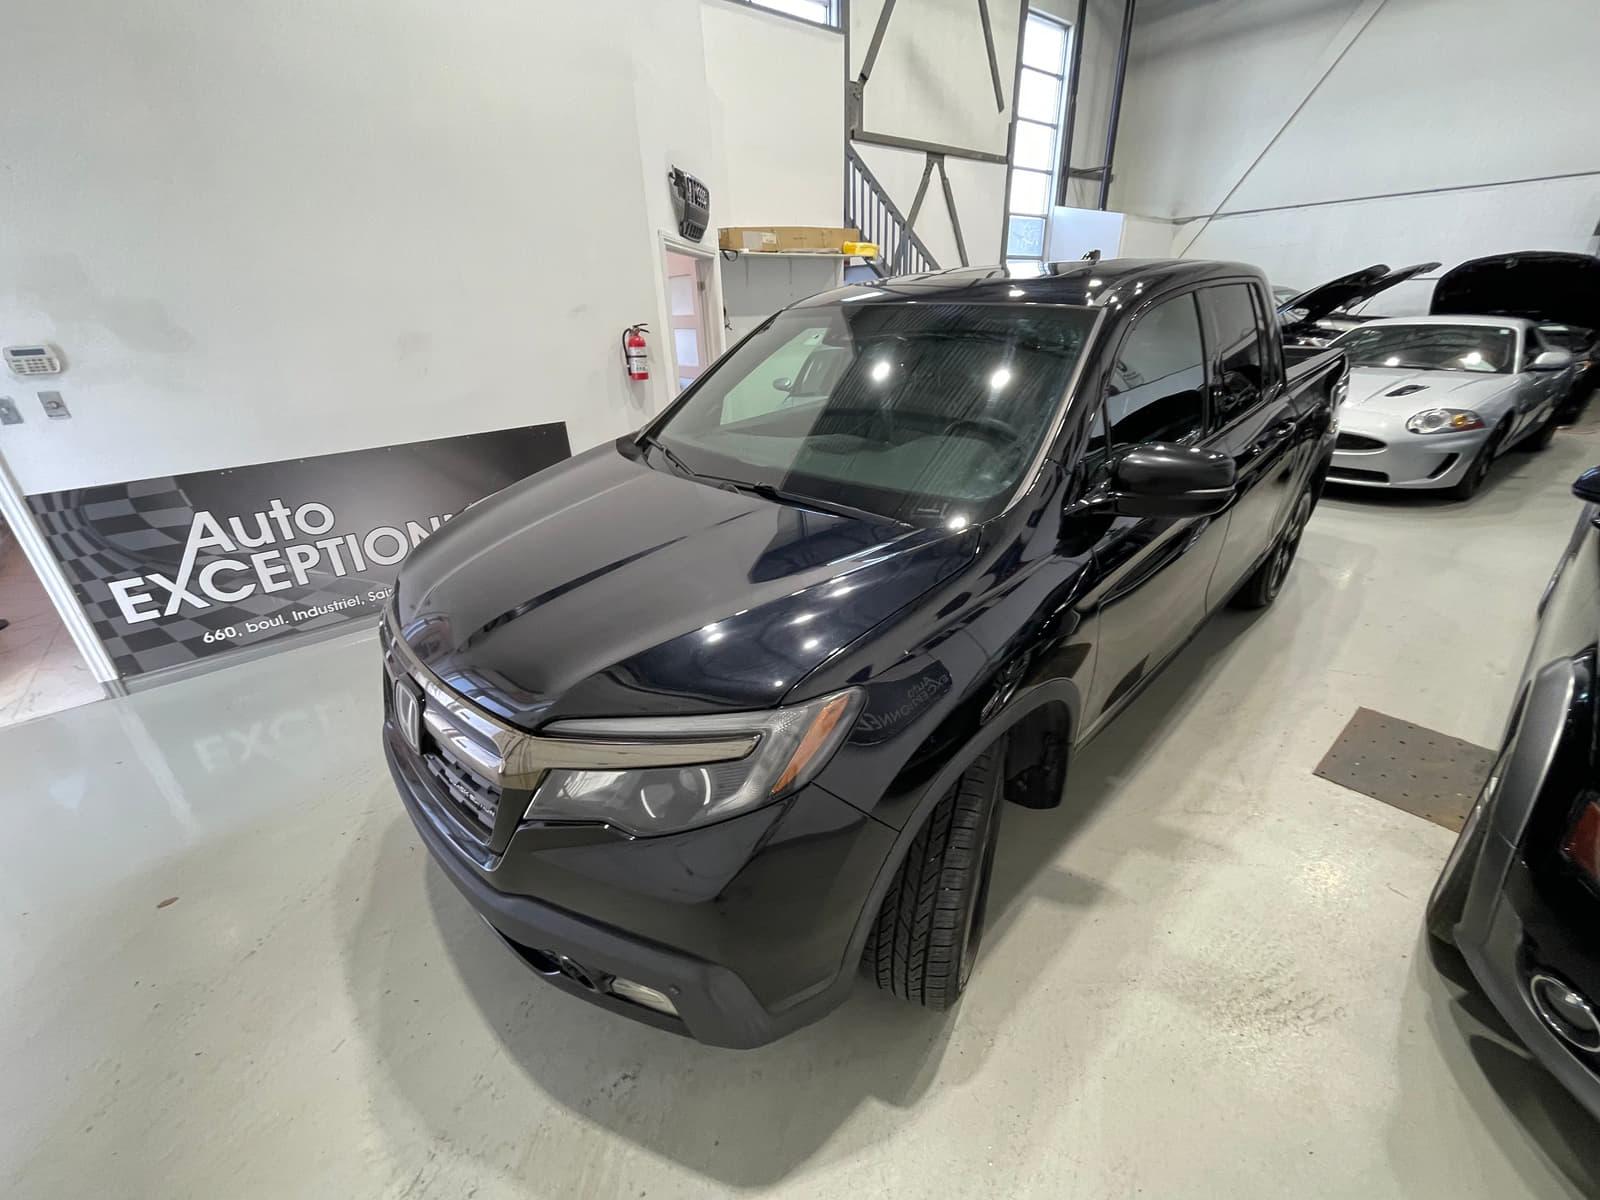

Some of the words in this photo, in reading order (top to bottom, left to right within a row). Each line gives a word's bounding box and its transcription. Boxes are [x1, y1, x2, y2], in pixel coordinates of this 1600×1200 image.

[187, 499, 335, 552] Auto
[203, 626, 242, 644] 660,
[246, 614, 289, 633] boul.
[292, 594, 365, 622] Industriel,
